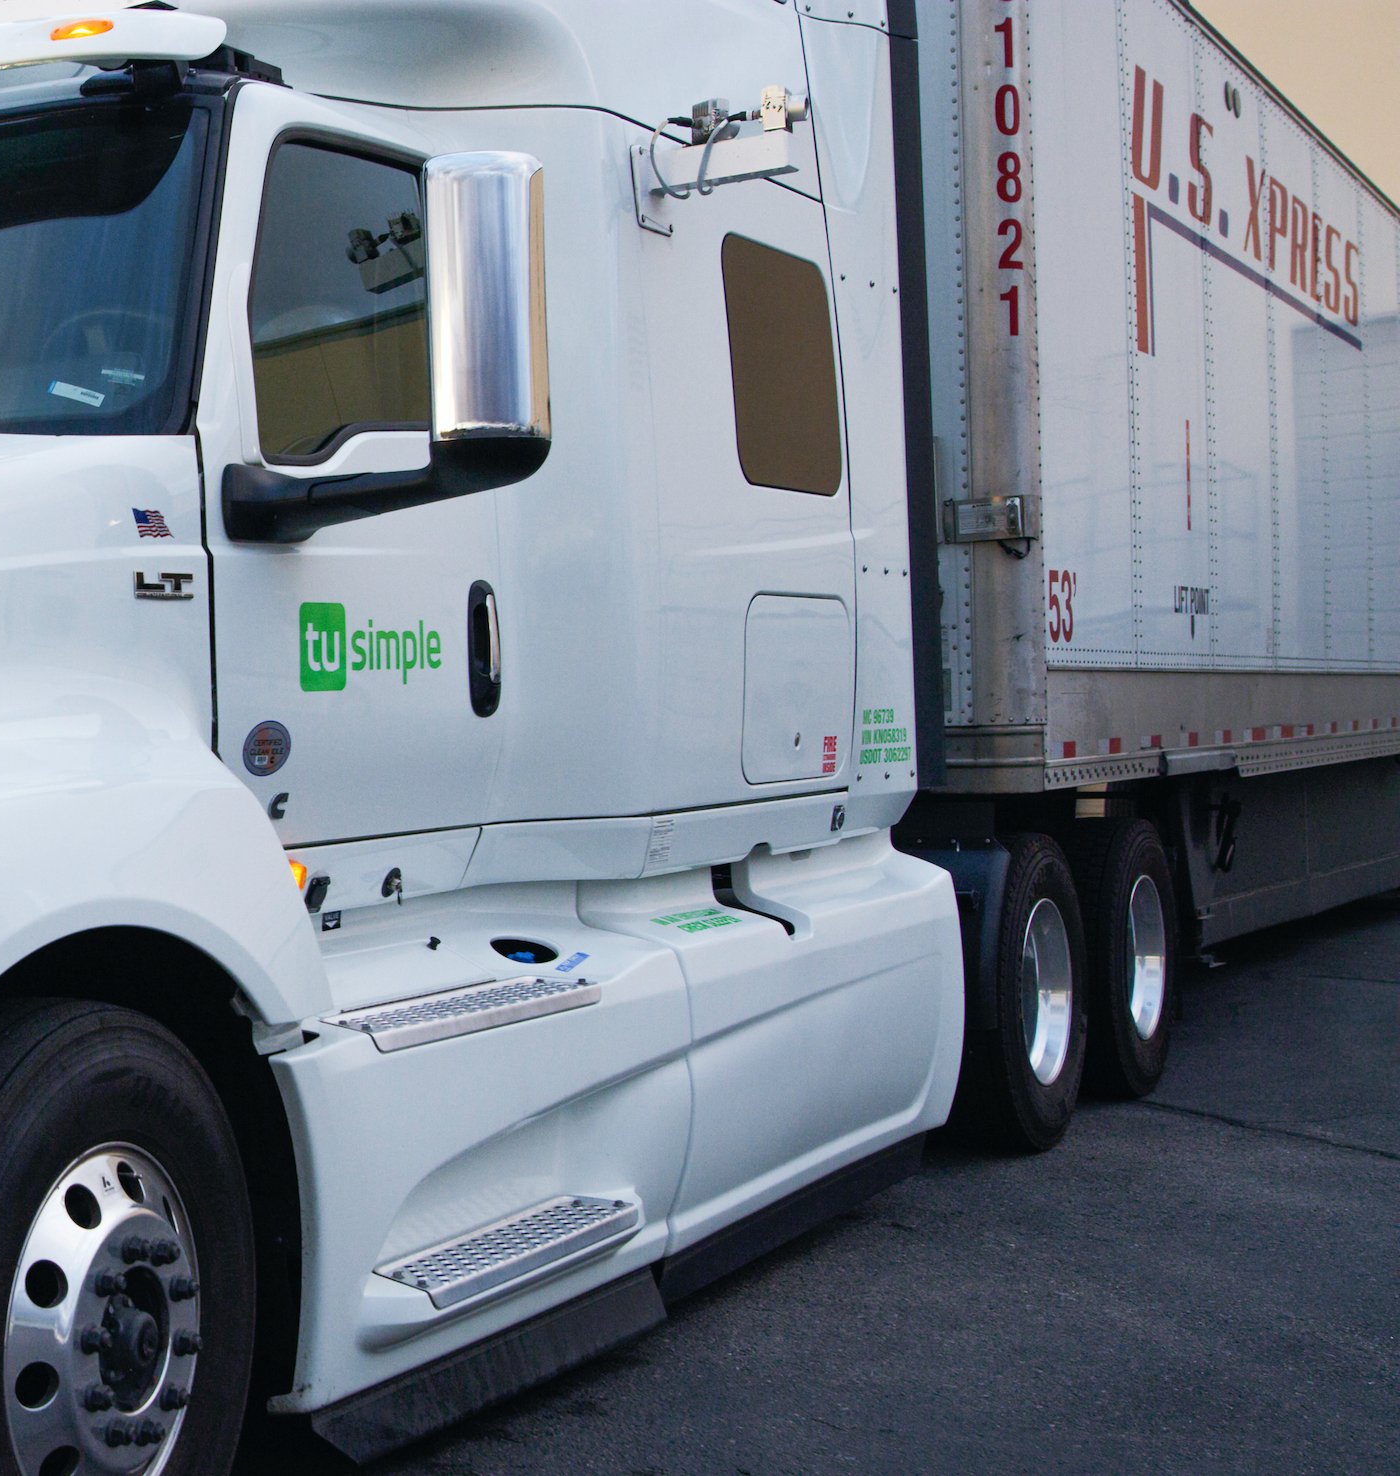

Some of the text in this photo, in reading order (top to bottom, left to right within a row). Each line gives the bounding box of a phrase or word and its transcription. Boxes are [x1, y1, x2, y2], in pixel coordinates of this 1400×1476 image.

[994, 0, 1023, 336] 10821
[1131, 64, 1360, 327] U.S. XPRESS
[133, 571, 193, 592] LT
[1049, 570, 1076, 643] 53'
[1174, 585, 1210, 615] LIFT POINT
[305, 619, 442, 685] tu simple
[859, 748, 882, 765] USDOT
